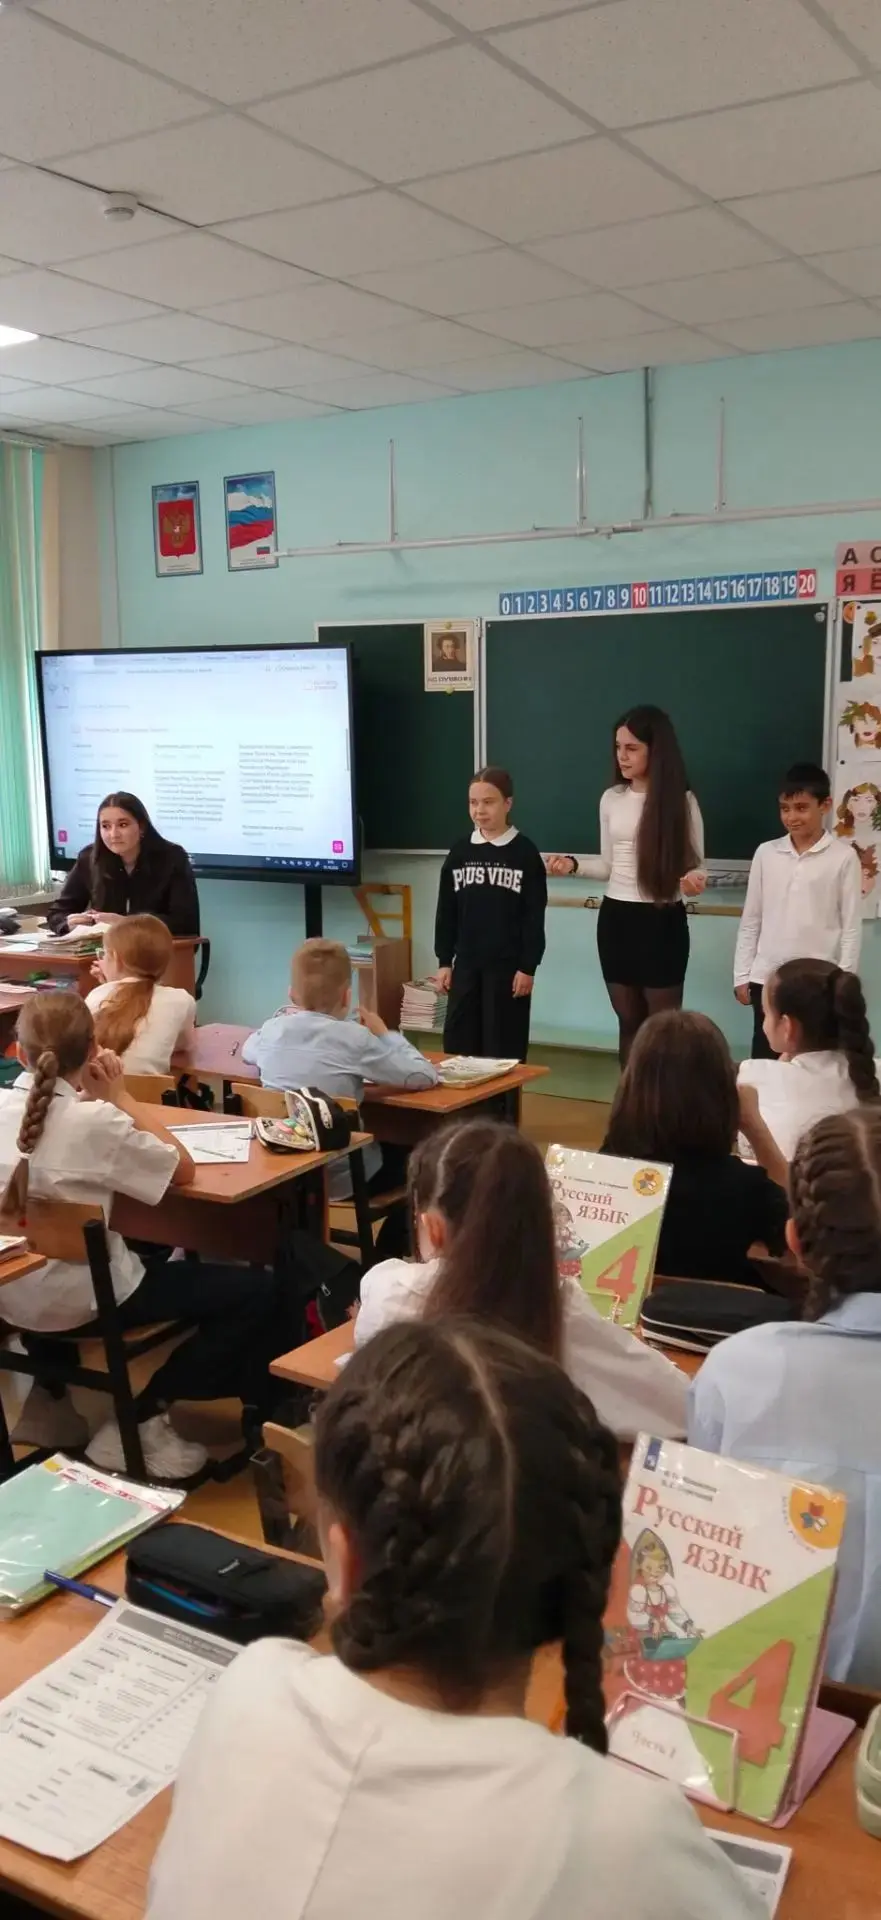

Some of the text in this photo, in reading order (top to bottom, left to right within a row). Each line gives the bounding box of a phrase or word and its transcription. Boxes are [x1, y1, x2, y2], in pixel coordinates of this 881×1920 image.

[842, 547, 858, 566] А
[502, 574, 816, 614] 0 1 2 3 4 5 6 7 8 9 10 11 12 13 14 15 16 17 18 19 20
[841, 574, 856, 593] Я
[487, 867, 524, 894] VIBE
[596, 1244, 640, 1305] 4
[632, 1484, 744, 1550] Русский
[708, 1638, 795, 1768] 4
